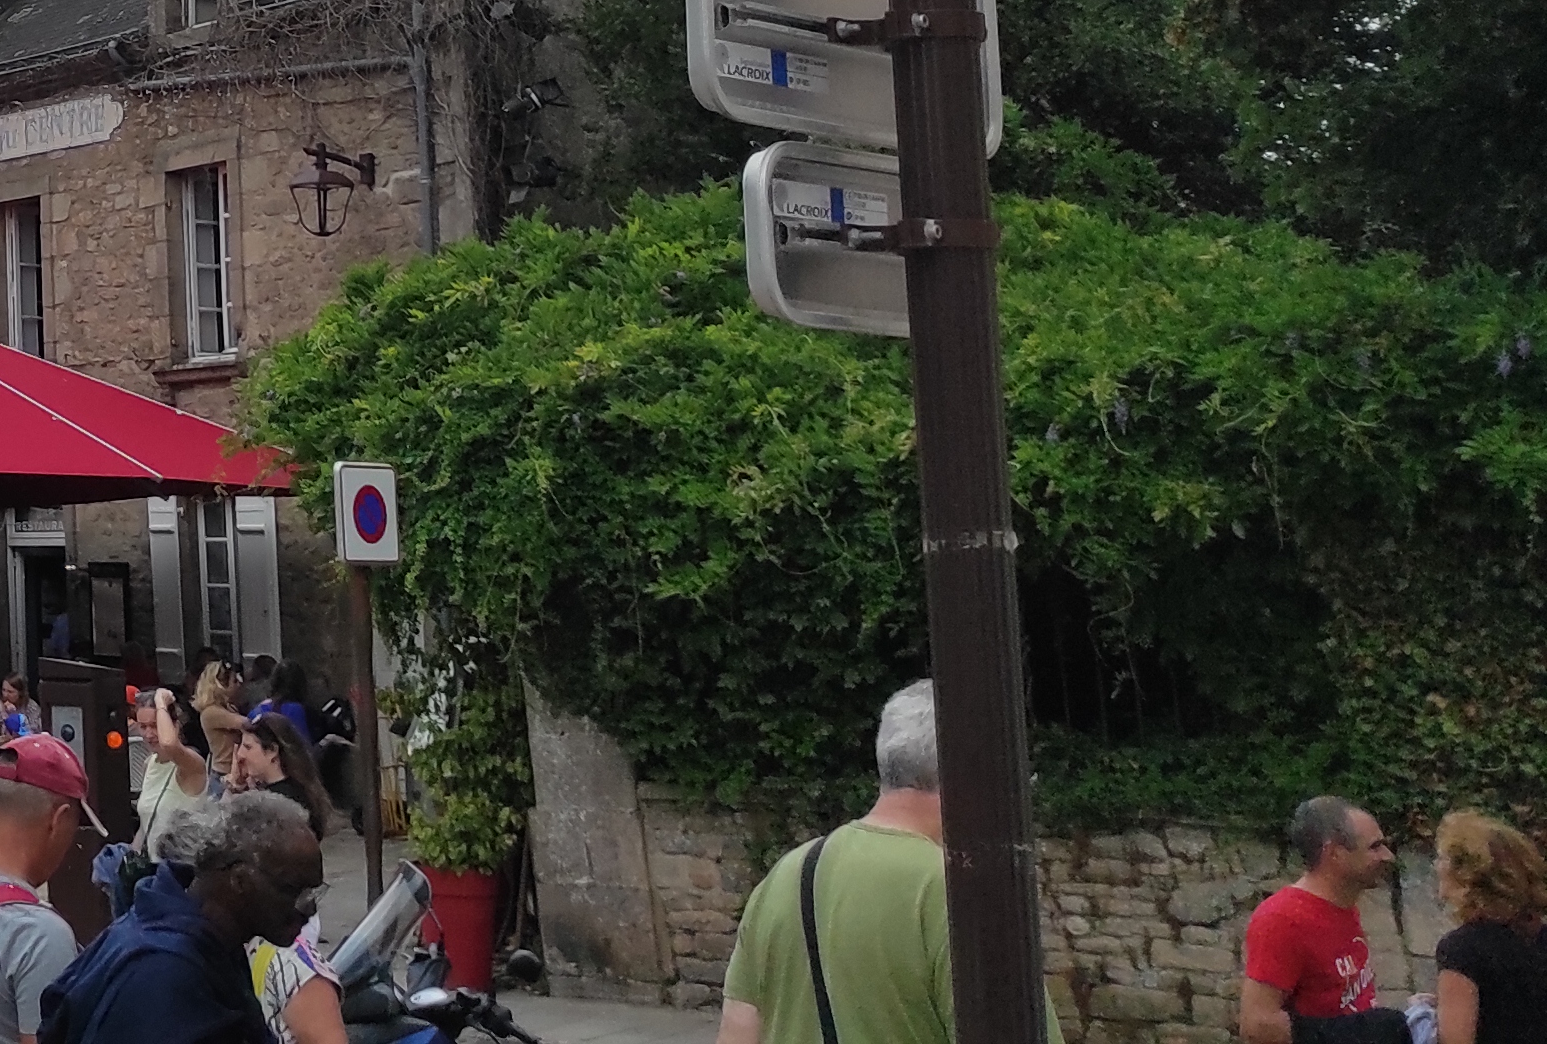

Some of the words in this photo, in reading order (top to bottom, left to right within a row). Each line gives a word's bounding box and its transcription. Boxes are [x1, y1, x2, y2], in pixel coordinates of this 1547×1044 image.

[727, 63, 772, 82] LACROIX
[25, 103, 105, 146] CENTRE
[786, 202, 832, 219] LACROIX
[15, 520, 64, 532] RESTAURA
